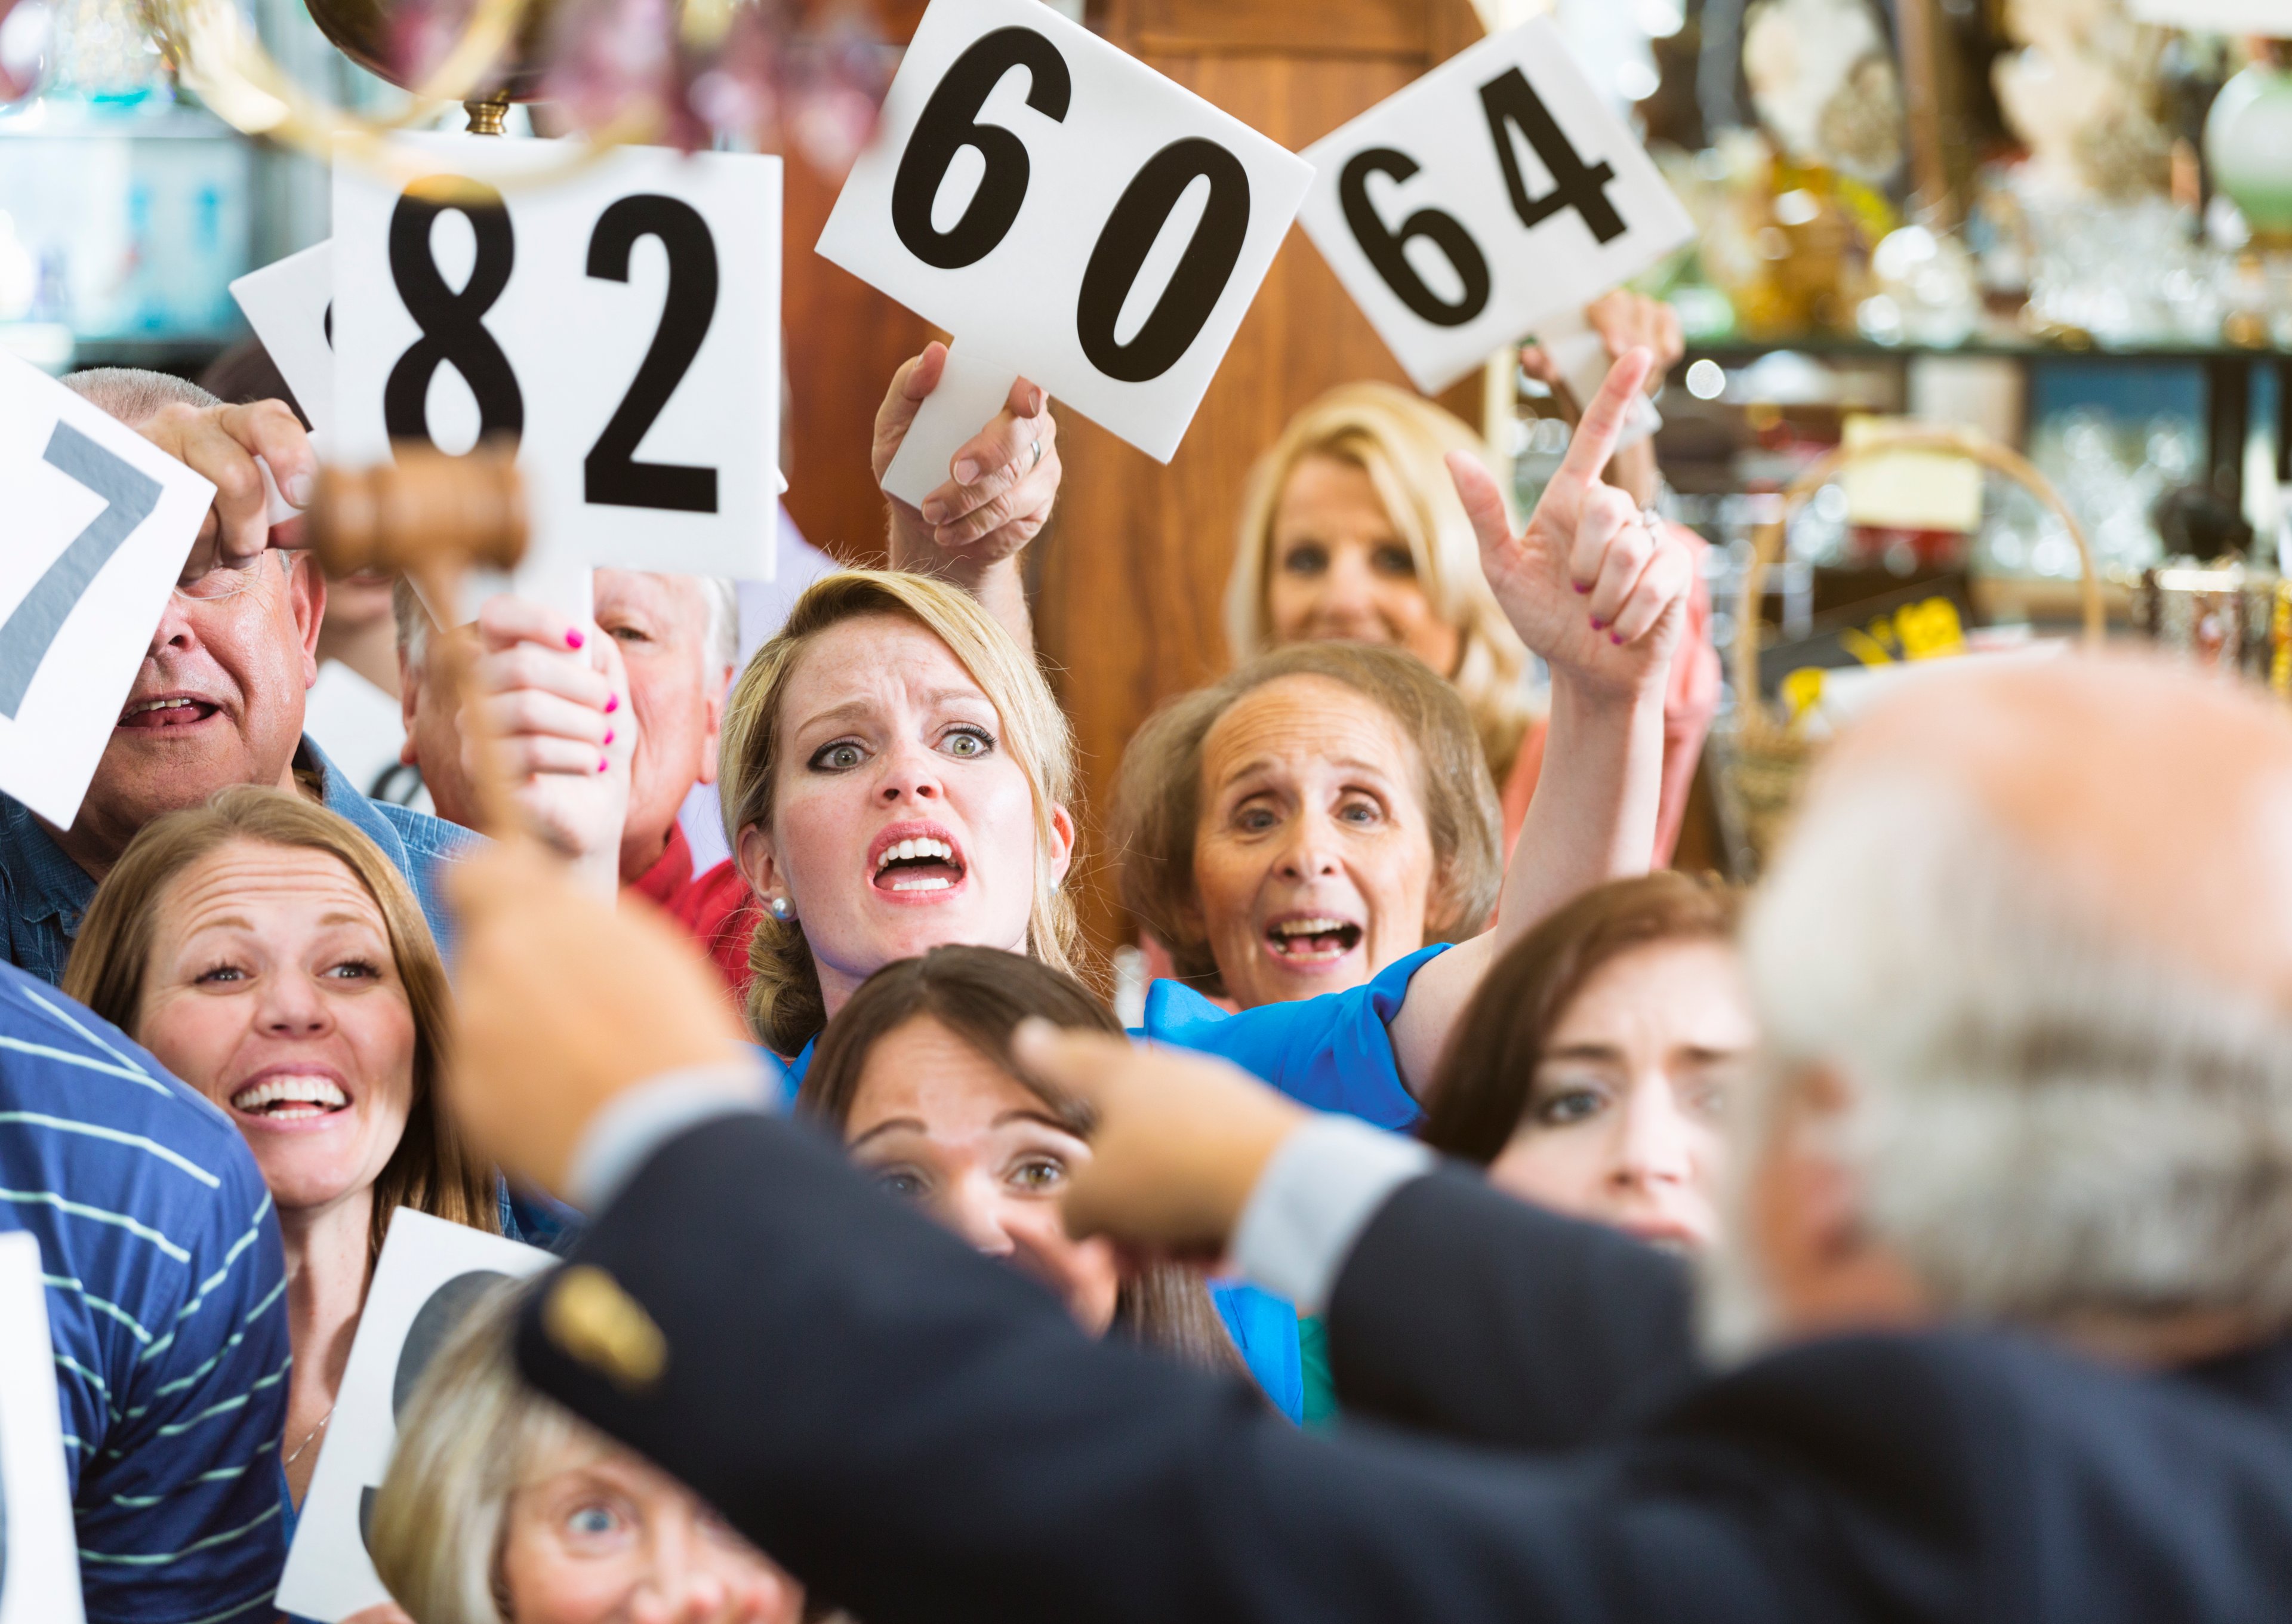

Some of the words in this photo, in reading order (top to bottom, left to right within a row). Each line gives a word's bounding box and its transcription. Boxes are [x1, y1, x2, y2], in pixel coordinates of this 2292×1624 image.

[383, 173, 719, 513] 82
[891, 25, 1250, 383] 60
[1339, 66, 1628, 328] 64
[0, 417, 164, 722] 7
